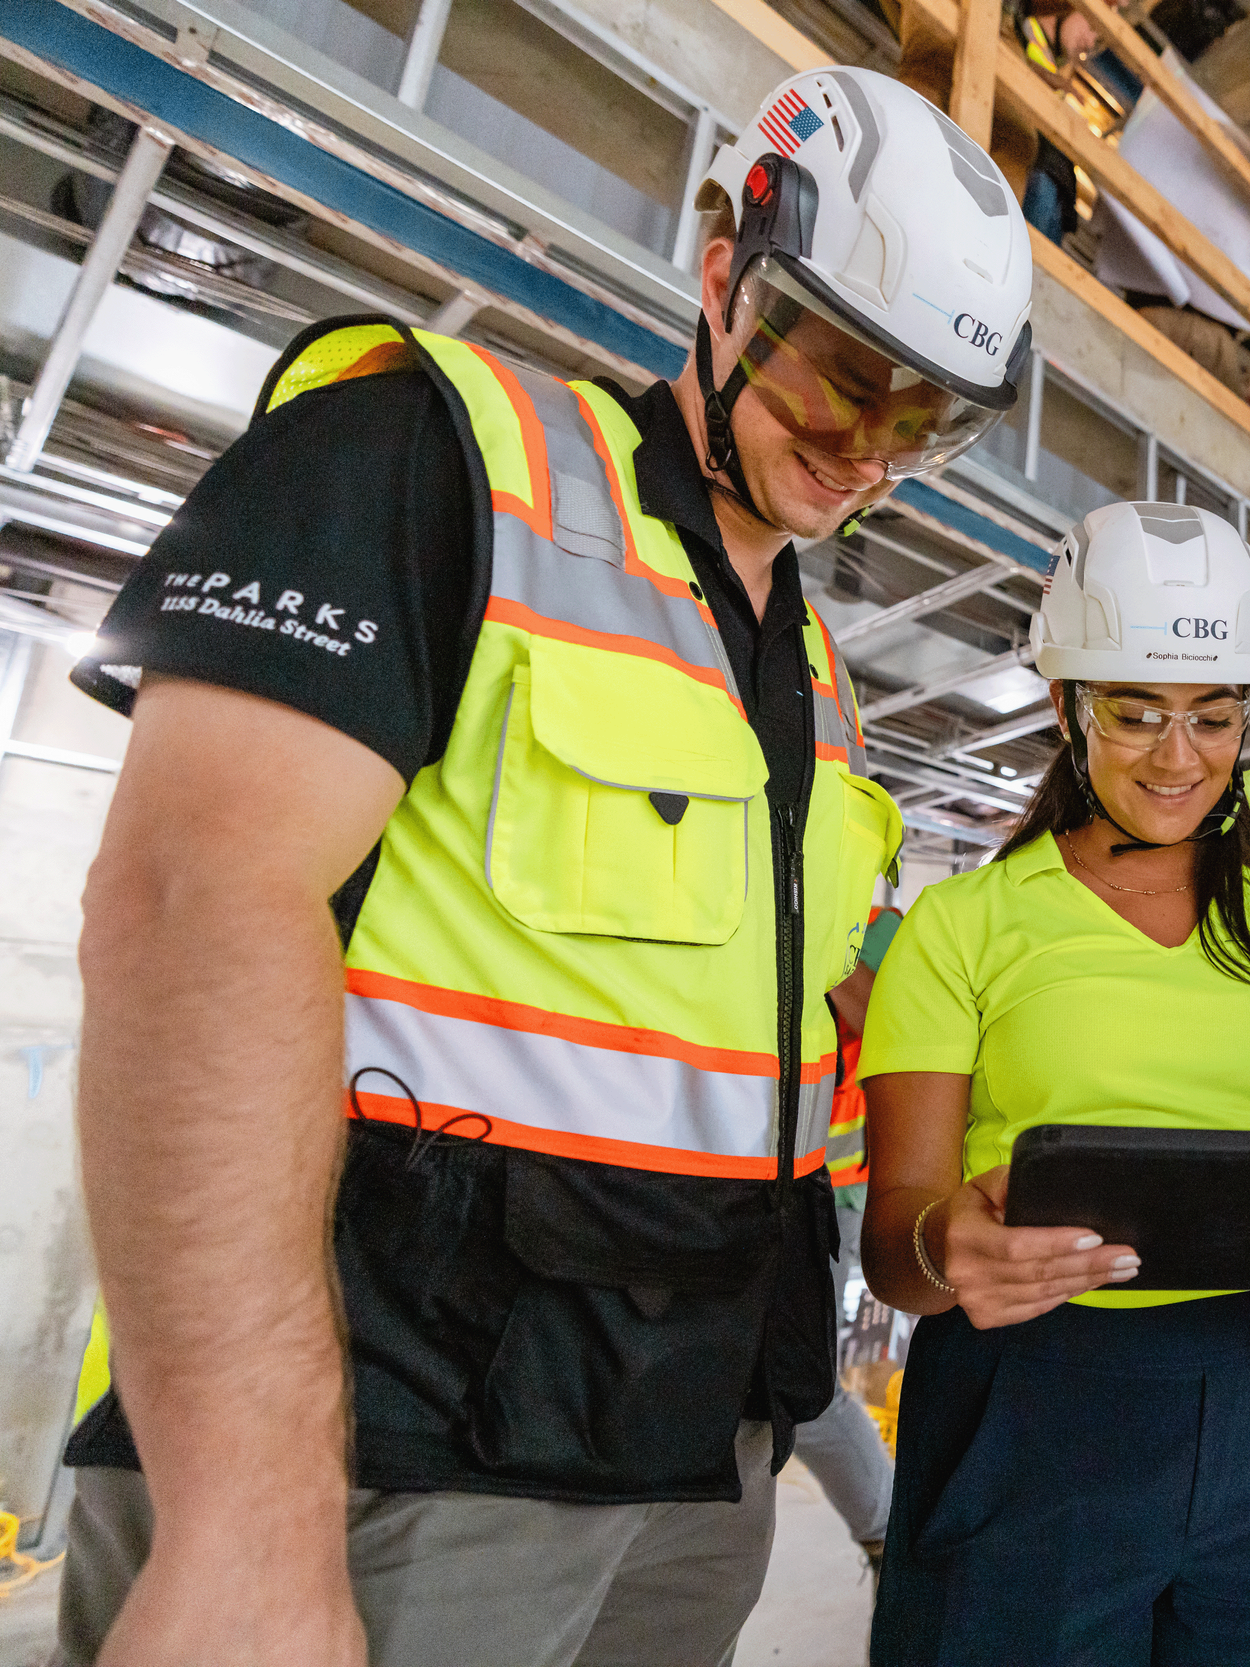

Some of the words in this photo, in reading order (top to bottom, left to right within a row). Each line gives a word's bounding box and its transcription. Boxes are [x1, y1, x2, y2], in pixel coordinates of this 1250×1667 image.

[954, 313, 1003, 356] CBG
[164, 573, 201, 588] THE
[201, 572, 378, 643] PARKS
[198, 597, 276, 630] Dahlia
[280, 619, 351, 656] Street
[1172, 617, 1228, 640] CBG
[1153, 652, 1178, 660] Sophia
[1182, 653, 1213, 661] Biciocchi
